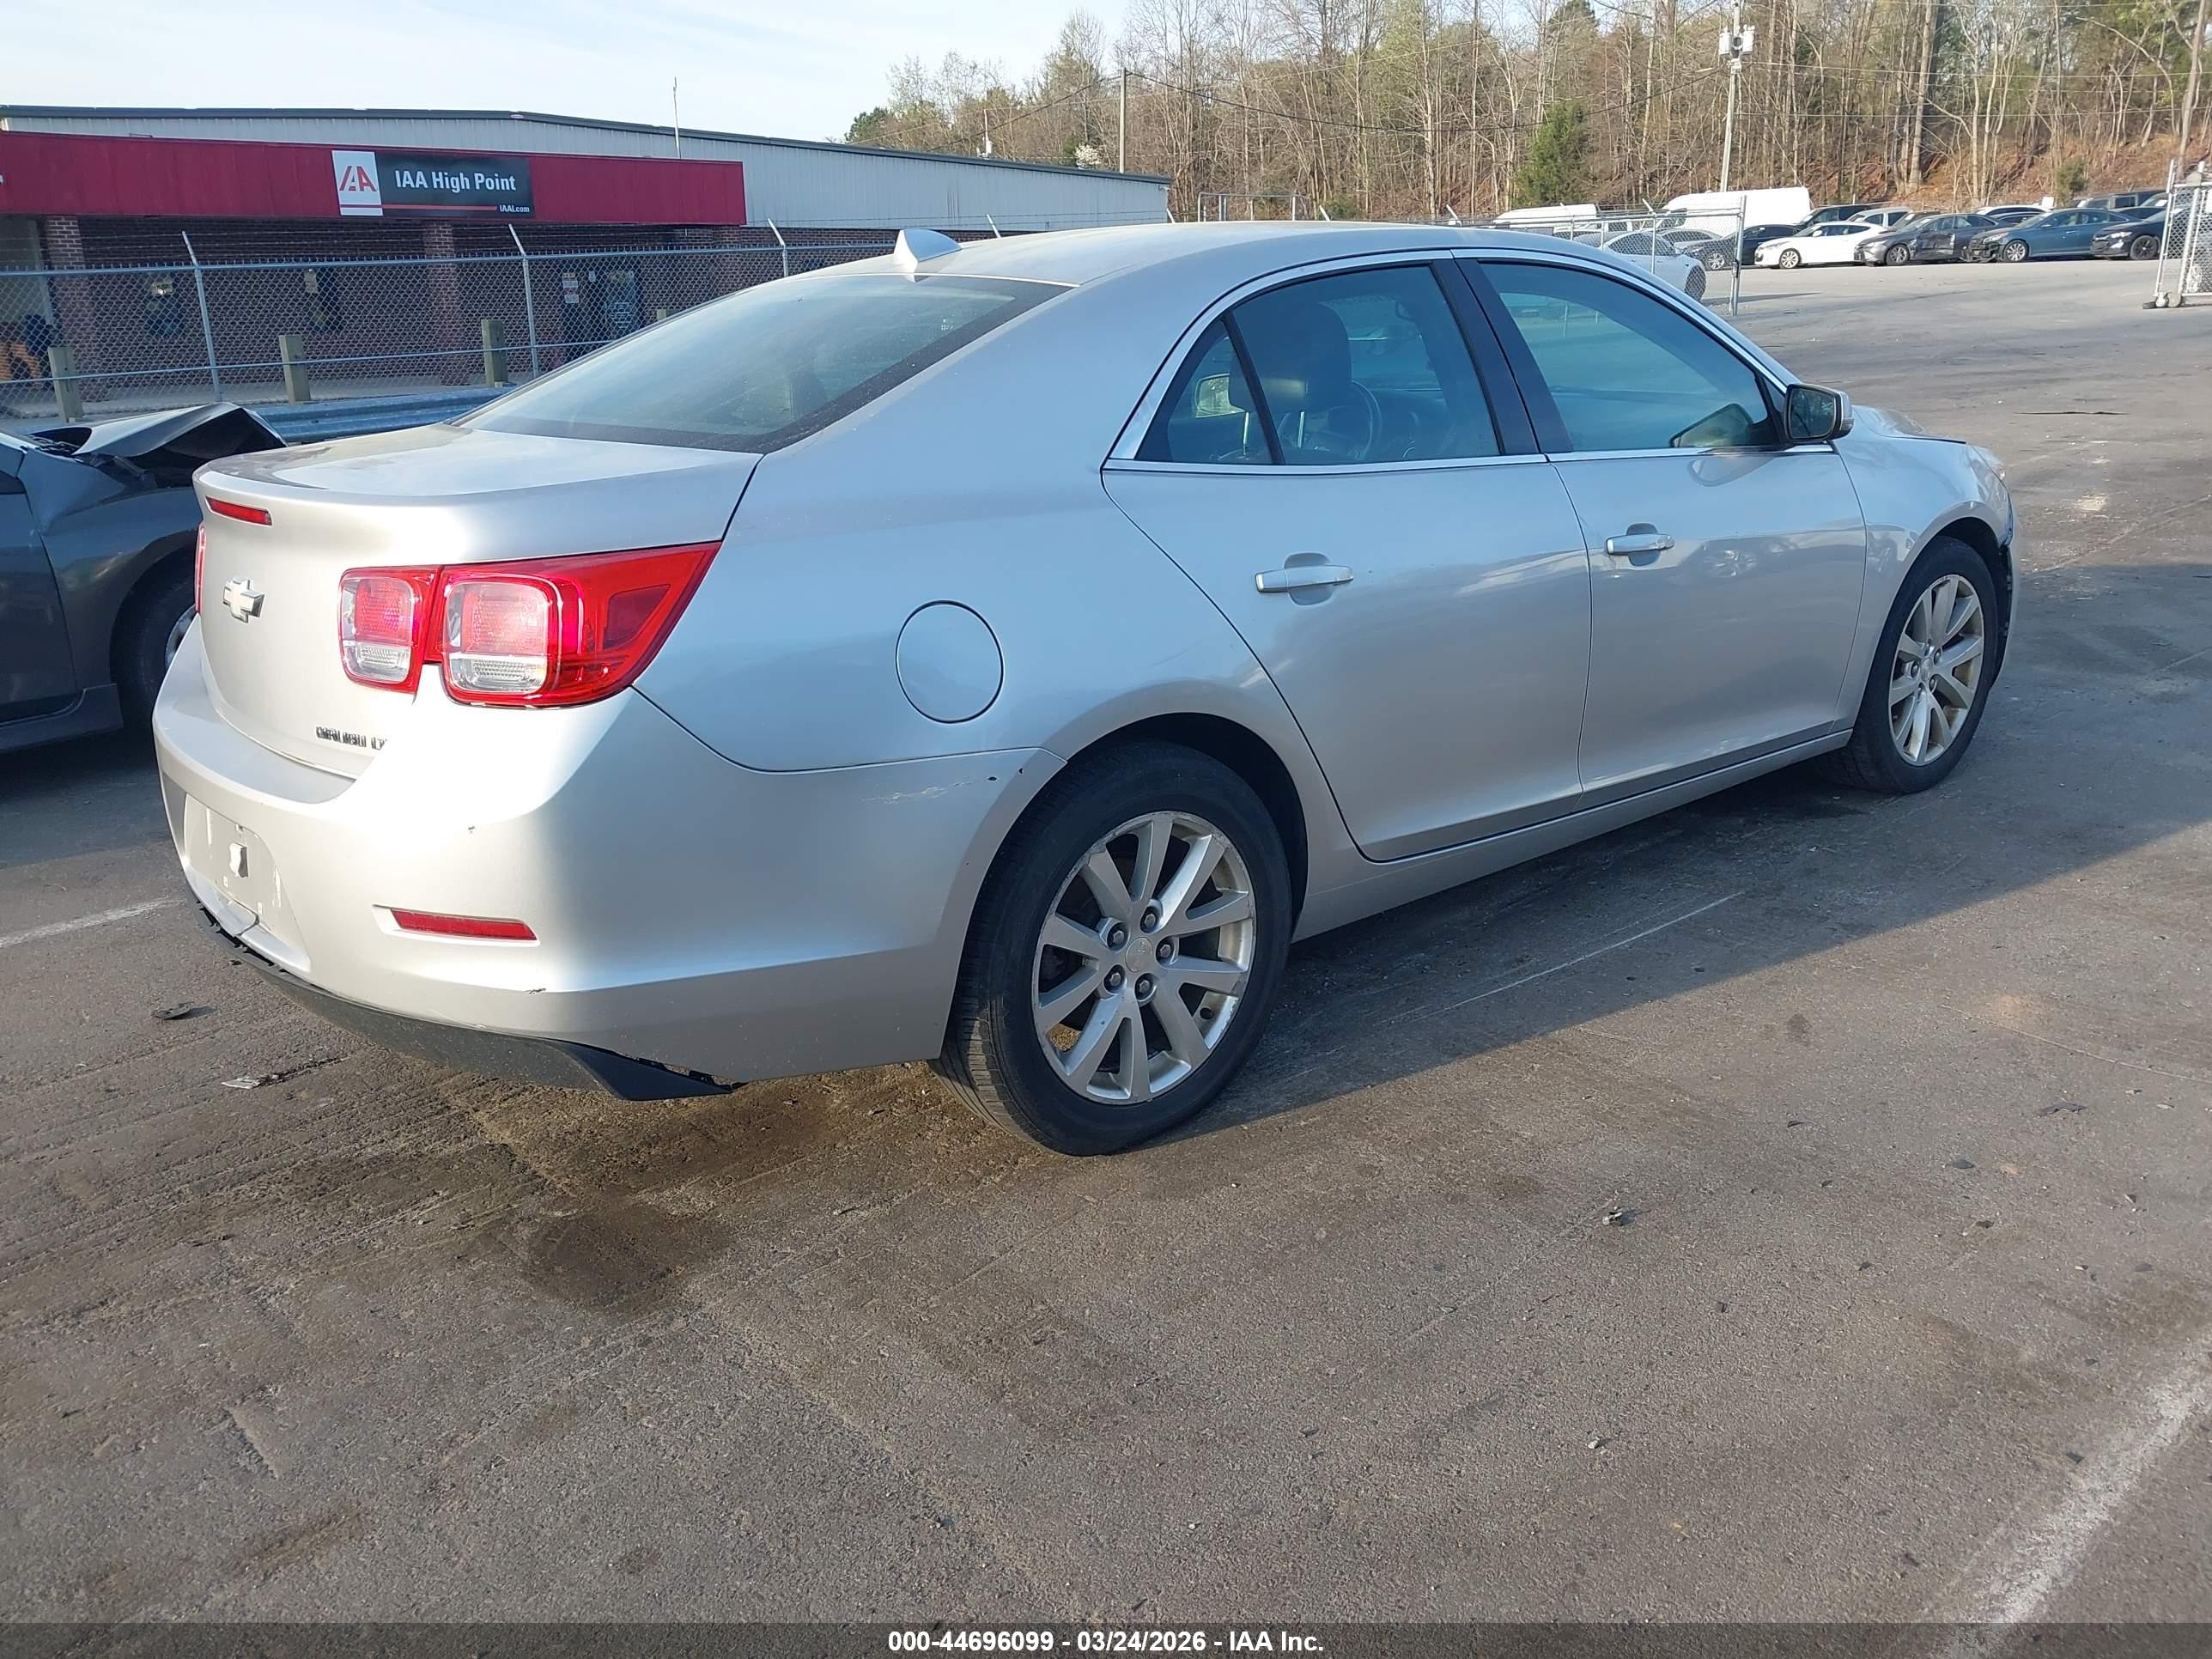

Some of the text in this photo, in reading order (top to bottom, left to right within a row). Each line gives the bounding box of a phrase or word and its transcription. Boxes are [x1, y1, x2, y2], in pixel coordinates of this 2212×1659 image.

[394, 170, 516, 193] IAA High Point
